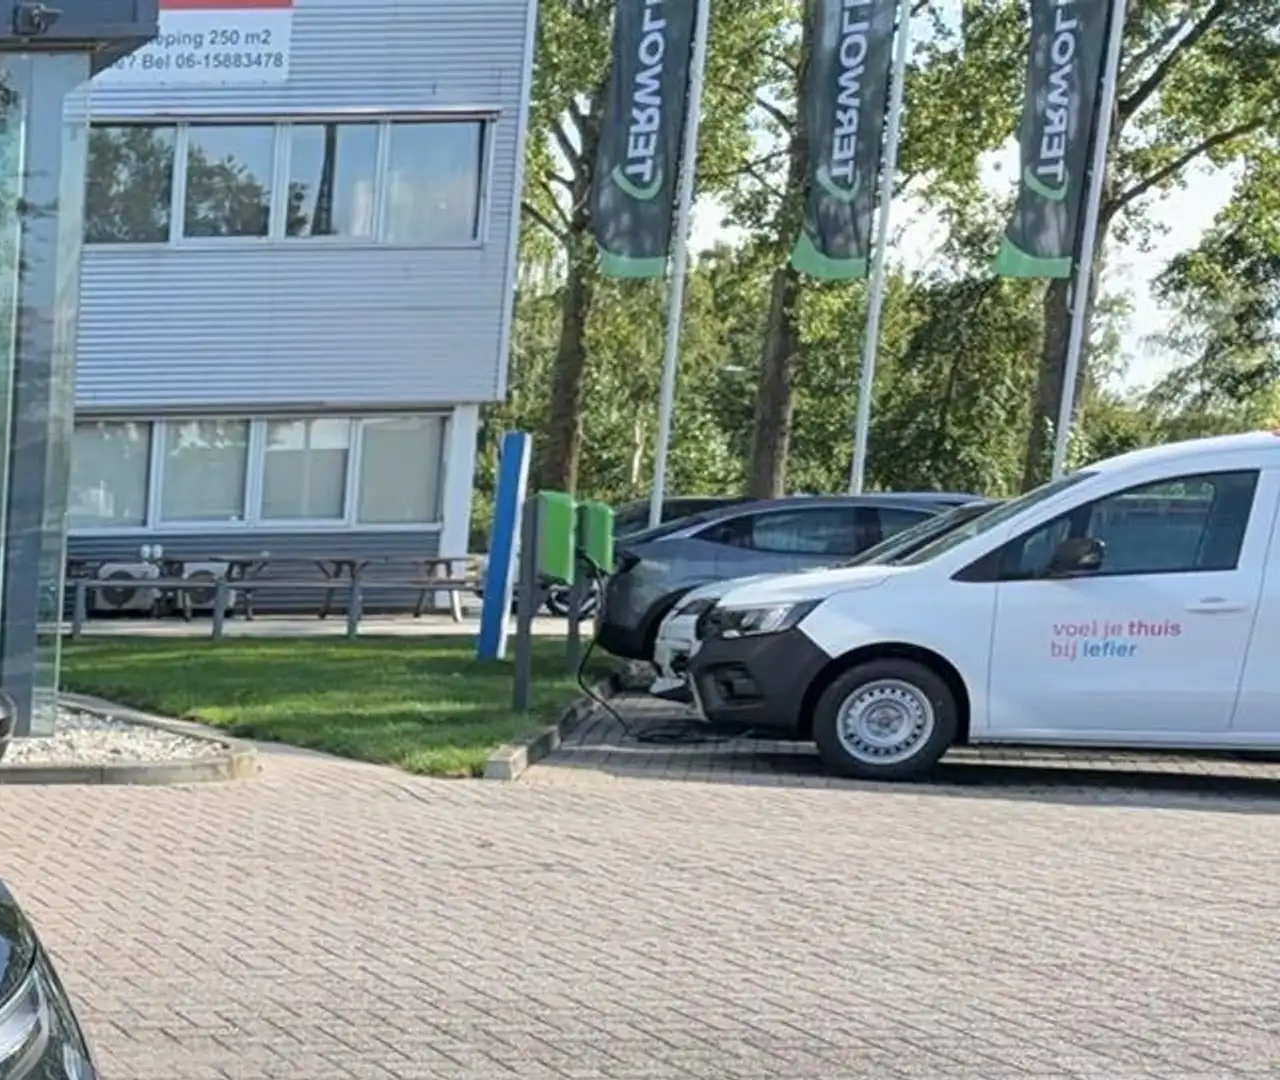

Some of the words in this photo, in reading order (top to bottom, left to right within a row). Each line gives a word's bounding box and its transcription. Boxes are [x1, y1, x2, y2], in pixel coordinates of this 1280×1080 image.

[209, 29, 240, 45] 250
[244, 29, 272, 45] m2
[142, 53, 170, 70] Bel
[1053, 621, 1097, 636] voel
[1104, 620, 1123, 640] je
[1128, 620, 1181, 636] thuis
[1051, 640, 1076, 661] bij
